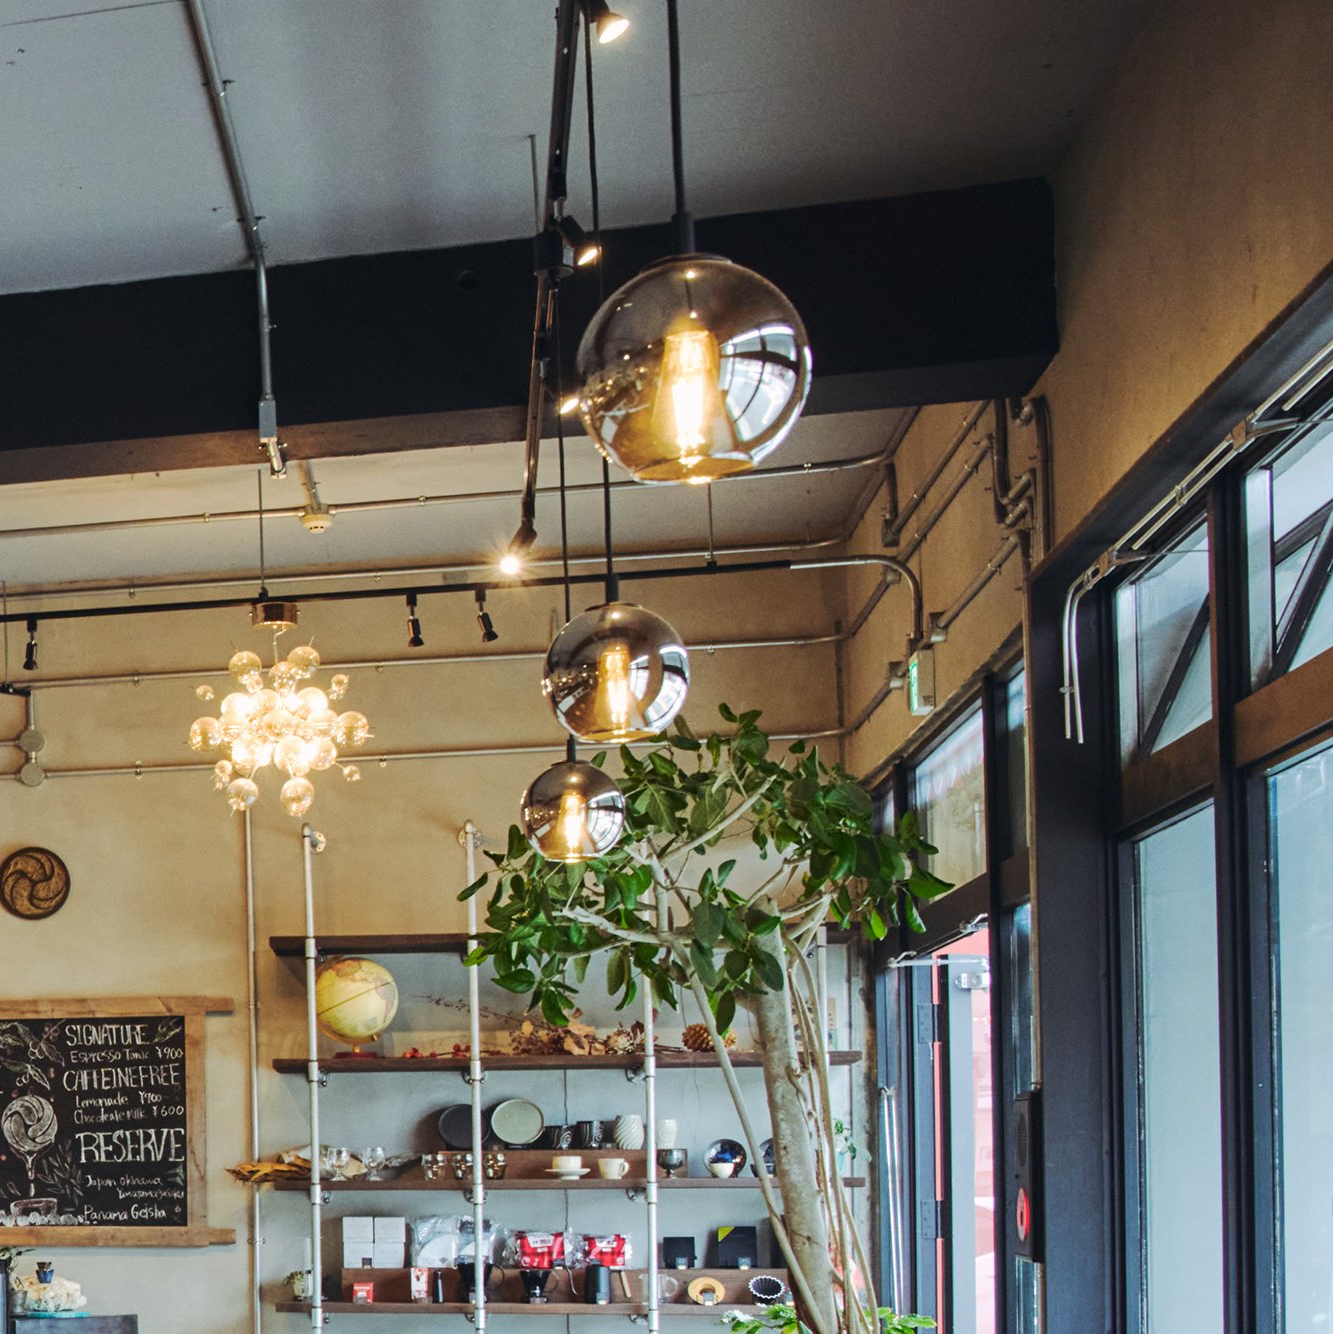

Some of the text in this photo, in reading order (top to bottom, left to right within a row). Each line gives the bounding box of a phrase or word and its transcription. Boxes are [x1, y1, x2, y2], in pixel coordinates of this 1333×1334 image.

[65, 1024, 150, 1046] SIGNATURE
[70, 1049, 122, 1064] Espresso
[75, 1091, 129, 1109] Lemonade
[151, 1105, 184, 1119] ¥600
[75, 1128, 185, 1163] RESERVE
[86, 1174, 117, 1191] Japan
[84, 1203, 167, 1221] Panama Geisha
